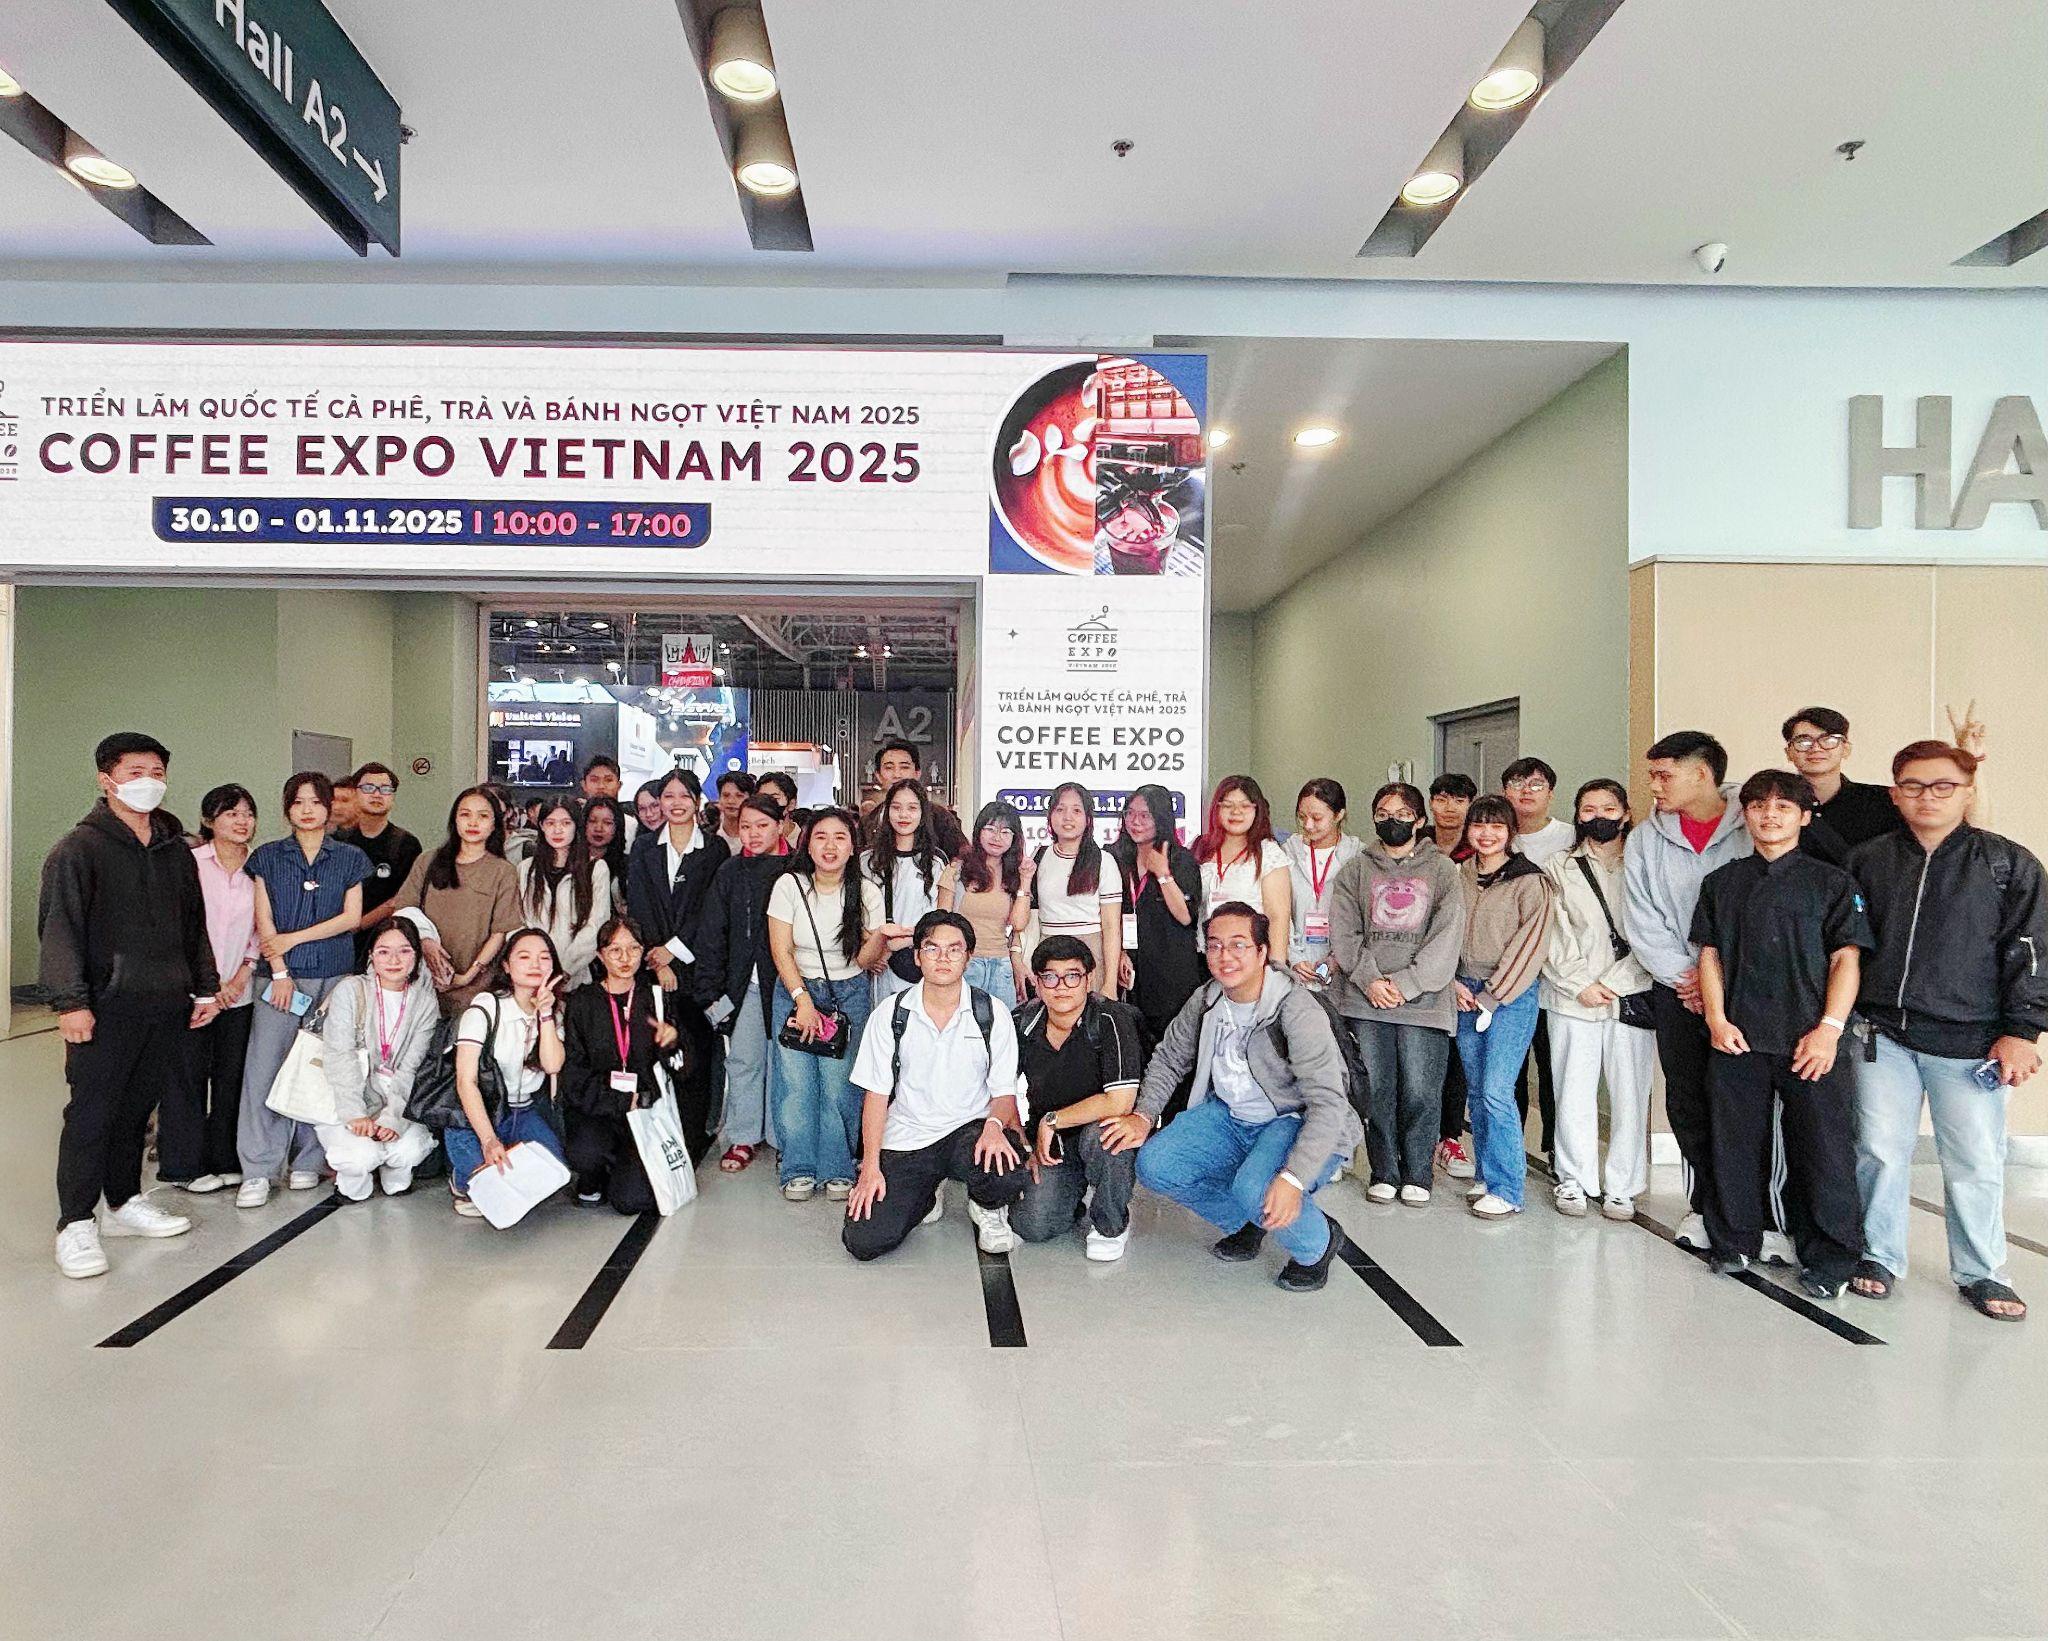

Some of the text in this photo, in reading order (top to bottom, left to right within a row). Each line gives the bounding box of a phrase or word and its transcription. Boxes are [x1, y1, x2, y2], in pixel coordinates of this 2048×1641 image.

[215, 0, 348, 168] Hall A2
[40, 387, 920, 429] TRIỂN LÃM QUỐC TẾ CÀ PHÊ, TRÀ VÀ BÁNH NGỌT VIỆT NAM 2025
[39, 432, 921, 484] COFFEE EXPO VIETNAM 2025
[171, 507, 260, 533] 30.10
[295, 508, 463, 535] 01.11.2025
[493, 511, 578, 536] 10:00
[611, 513, 692, 538] 17:00
[1067, 633, 1118, 644] COFFEE
[874, 705, 932, 741] A2
[1056, 704, 1090, 716] NGỌT
[1094, 703, 1124, 717] VIỆT
[1128, 705, 1154, 714] NAM
[1159, 705, 1187, 715] 2025
[997, 725, 1186, 747] COFFEE EXPO
[996, 751, 1186, 772] VIETNAM 2025
